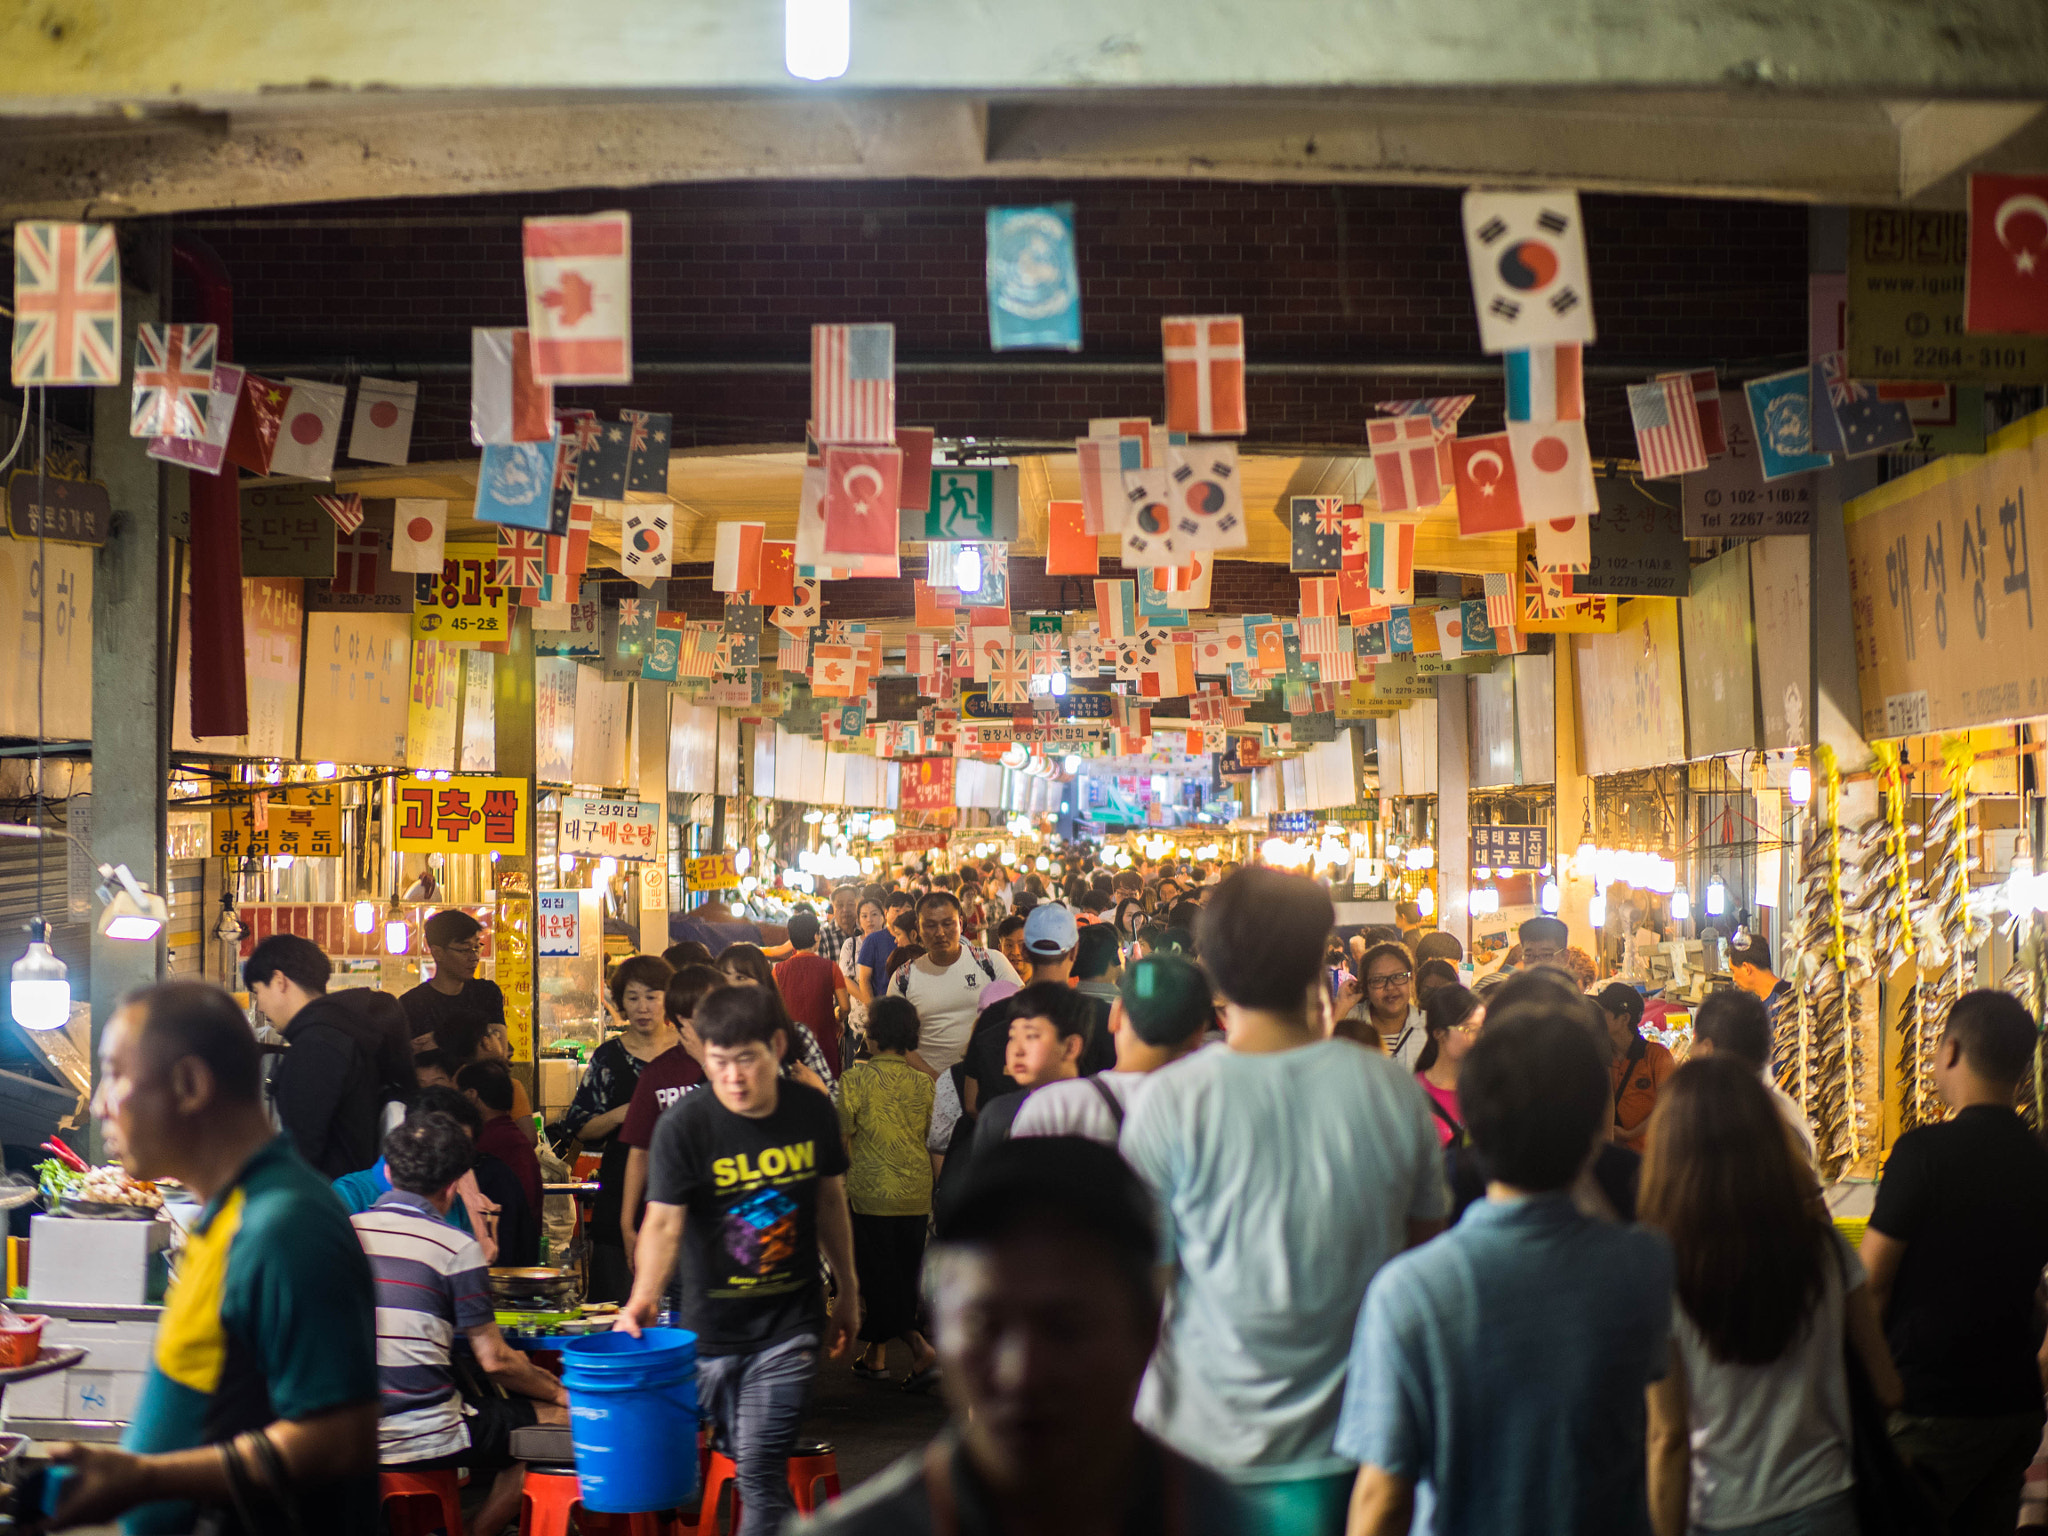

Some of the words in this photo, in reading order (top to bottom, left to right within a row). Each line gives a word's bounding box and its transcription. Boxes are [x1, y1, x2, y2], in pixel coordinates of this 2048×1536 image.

[451, 617, 499, 631] 45-2호
[584, 803, 639, 818] 은성회집
[699, 858, 738, 880] 김치
[712, 1140, 815, 1187] SLOW
